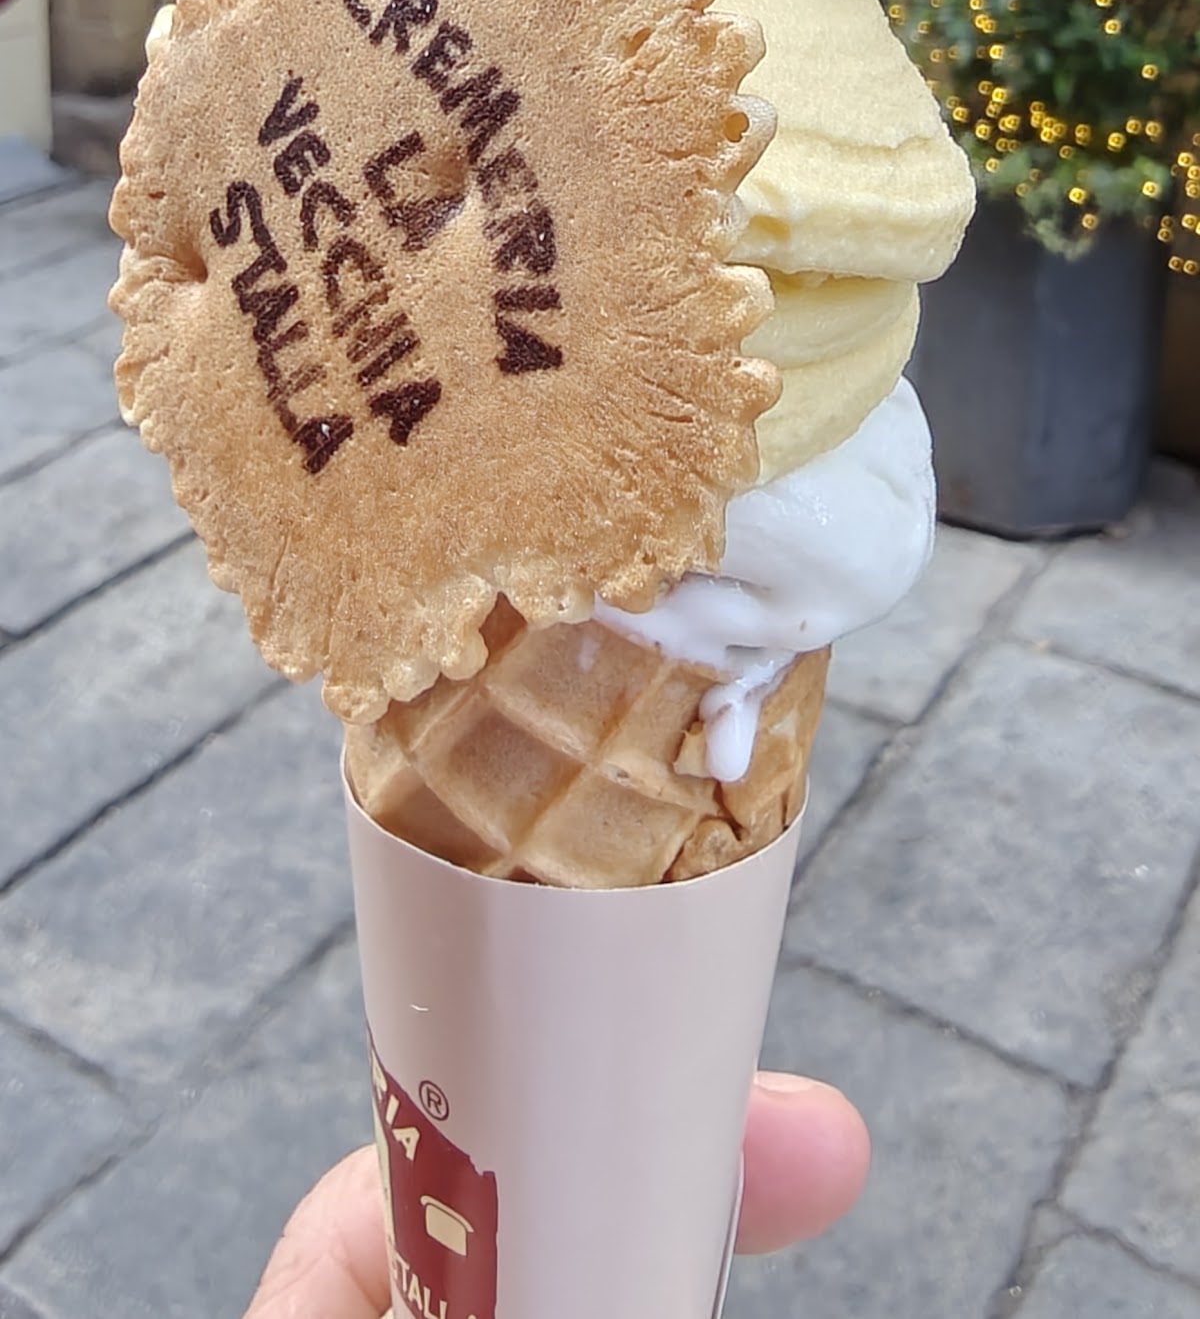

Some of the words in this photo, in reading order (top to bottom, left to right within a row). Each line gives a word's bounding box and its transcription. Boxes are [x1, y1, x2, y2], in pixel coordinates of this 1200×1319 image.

[258, 75, 442, 446] VECCHIA
[363, 130, 467, 252] LA
[209, 181, 354, 474] STALLA
[389, 1250, 477, 1319] STALL
